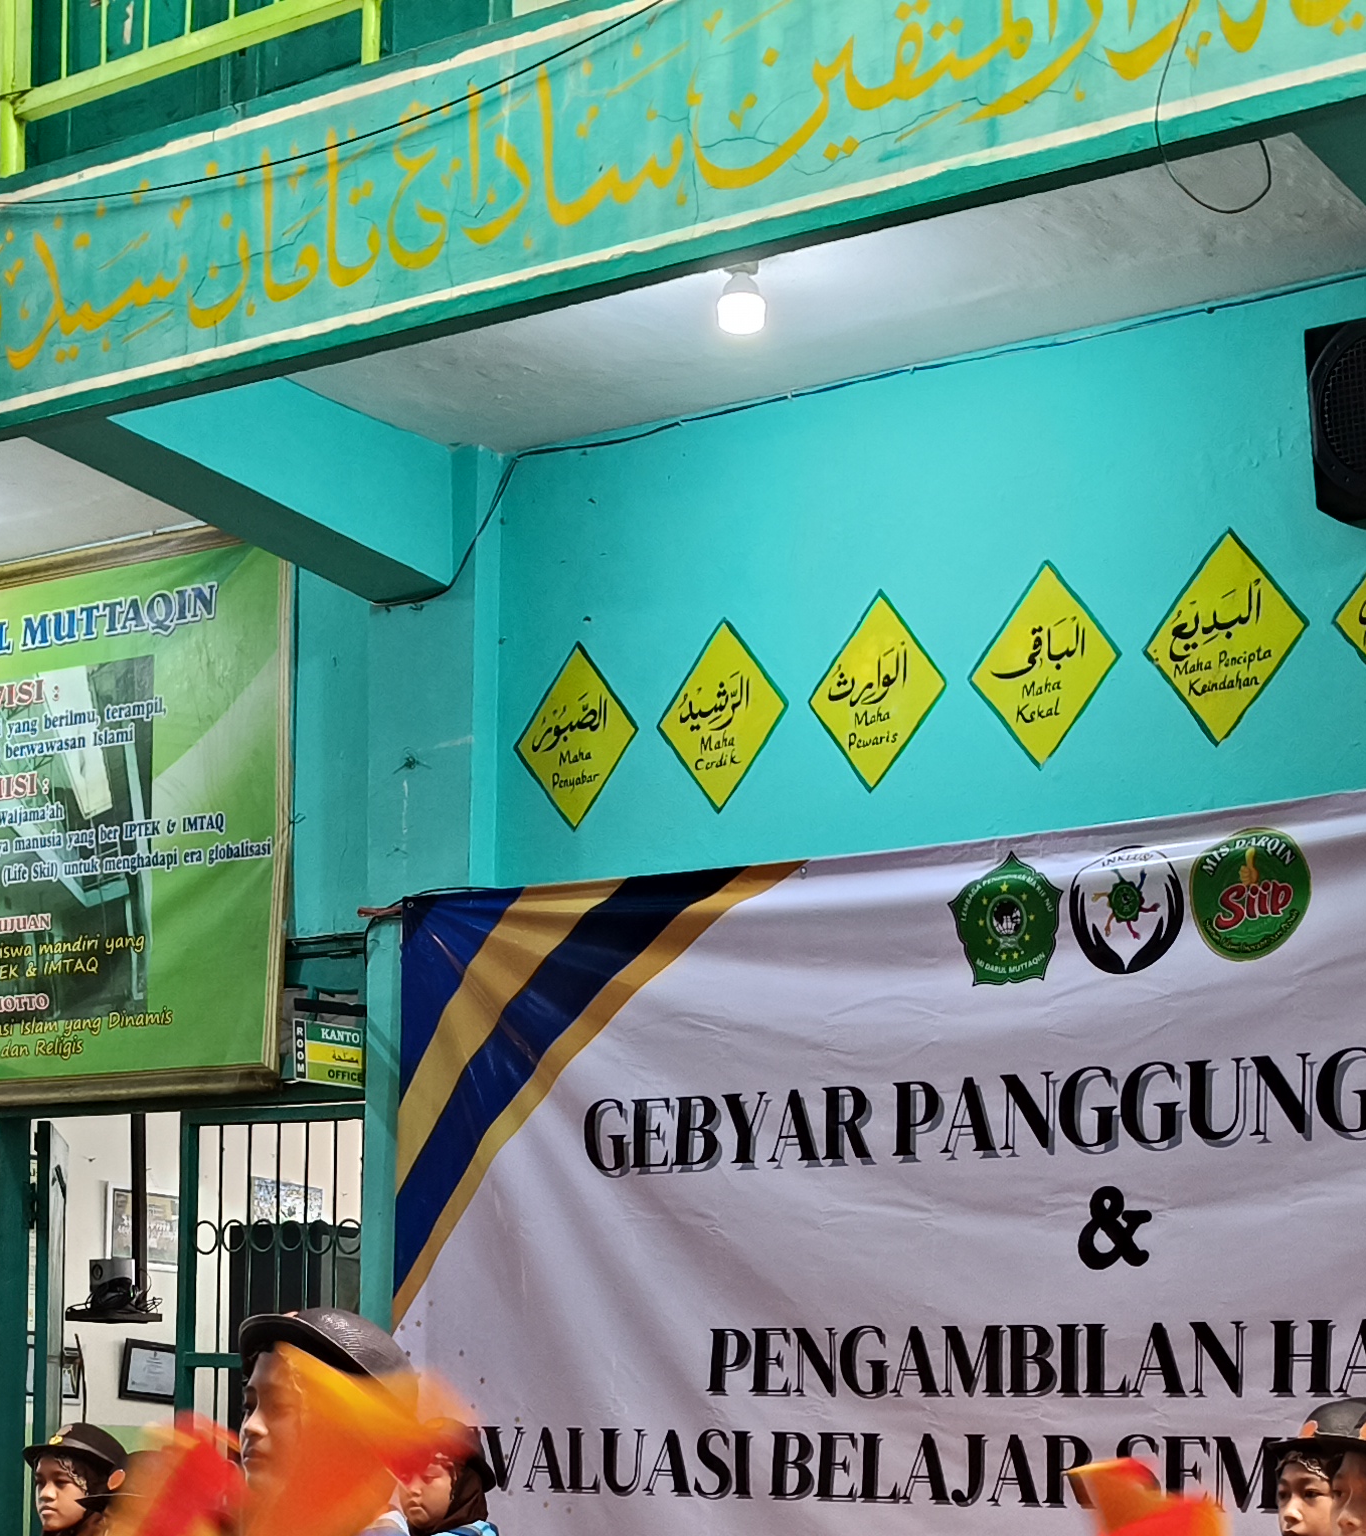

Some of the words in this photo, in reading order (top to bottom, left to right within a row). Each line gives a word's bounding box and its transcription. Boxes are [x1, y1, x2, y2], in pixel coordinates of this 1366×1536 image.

[20, 582, 219, 651] MUTTAQIN
[1174, 655, 1212, 678] Maha
[1218, 647, 1272, 672] Pencipta
[1022, 677, 1062, 699] Maha
[1188, 673, 1260, 697] Keindahan
[7, 715, 38, 736] yang
[44, 704, 100, 731] berilmu,
[106, 697, 167, 720] terampil,
[855, 707, 890, 728] Maha
[1016, 697, 1061, 723] Kekal
[5, 735, 86, 761] berwawasan
[93, 724, 135, 747] Islami
[700, 730, 735, 753] Maha
[848, 731, 898, 751] Pewaris
[559, 748, 592, 766] Maha
[694, 750, 741, 771] Cerdik
[551, 768, 599, 793] Penyabar
[14, 832, 62, 851] manusia
[67, 830, 95, 851] yang
[100, 825, 119, 842] ber
[124, 820, 161, 839] IPTEK
[166, 818, 177, 834] &
[183, 811, 225, 834] IMTAQ
[2, 866, 29, 886] (Life
[64, 858, 99, 877] untuk
[104, 848, 178, 875] menghadapi
[183, 850, 203, 864] era
[208, 838, 273, 866] globalisasi
[1201, 844, 1231, 877] MIS
[1234, 835, 1296, 865] DARQIN
[39, 935, 99, 955] mandiri
[105, 935, 145, 955] yang
[25, 965, 37, 979] &
[43, 958, 99, 976] IMTAQ
[20, 1015, 60, 1036] Islam
[64, 1016, 102, 1037] yang
[107, 1006, 174, 1028] Dinamis
[0, 1038, 30, 1059] dan
[34, 1036, 85, 1061] Religis
[296, 1026, 306, 1073] ROOM
[327, 1069, 364, 1083] OFFICE
[583, 1082, 873, 1178] GEBYAR
[1077, 1185, 1153, 1271] &
[705, 1320, 1245, 1399] PENGAMBILAN
[467, 1425, 754, 1500] VALUASI
[770, 1430, 1098, 1510] BELAJAR
